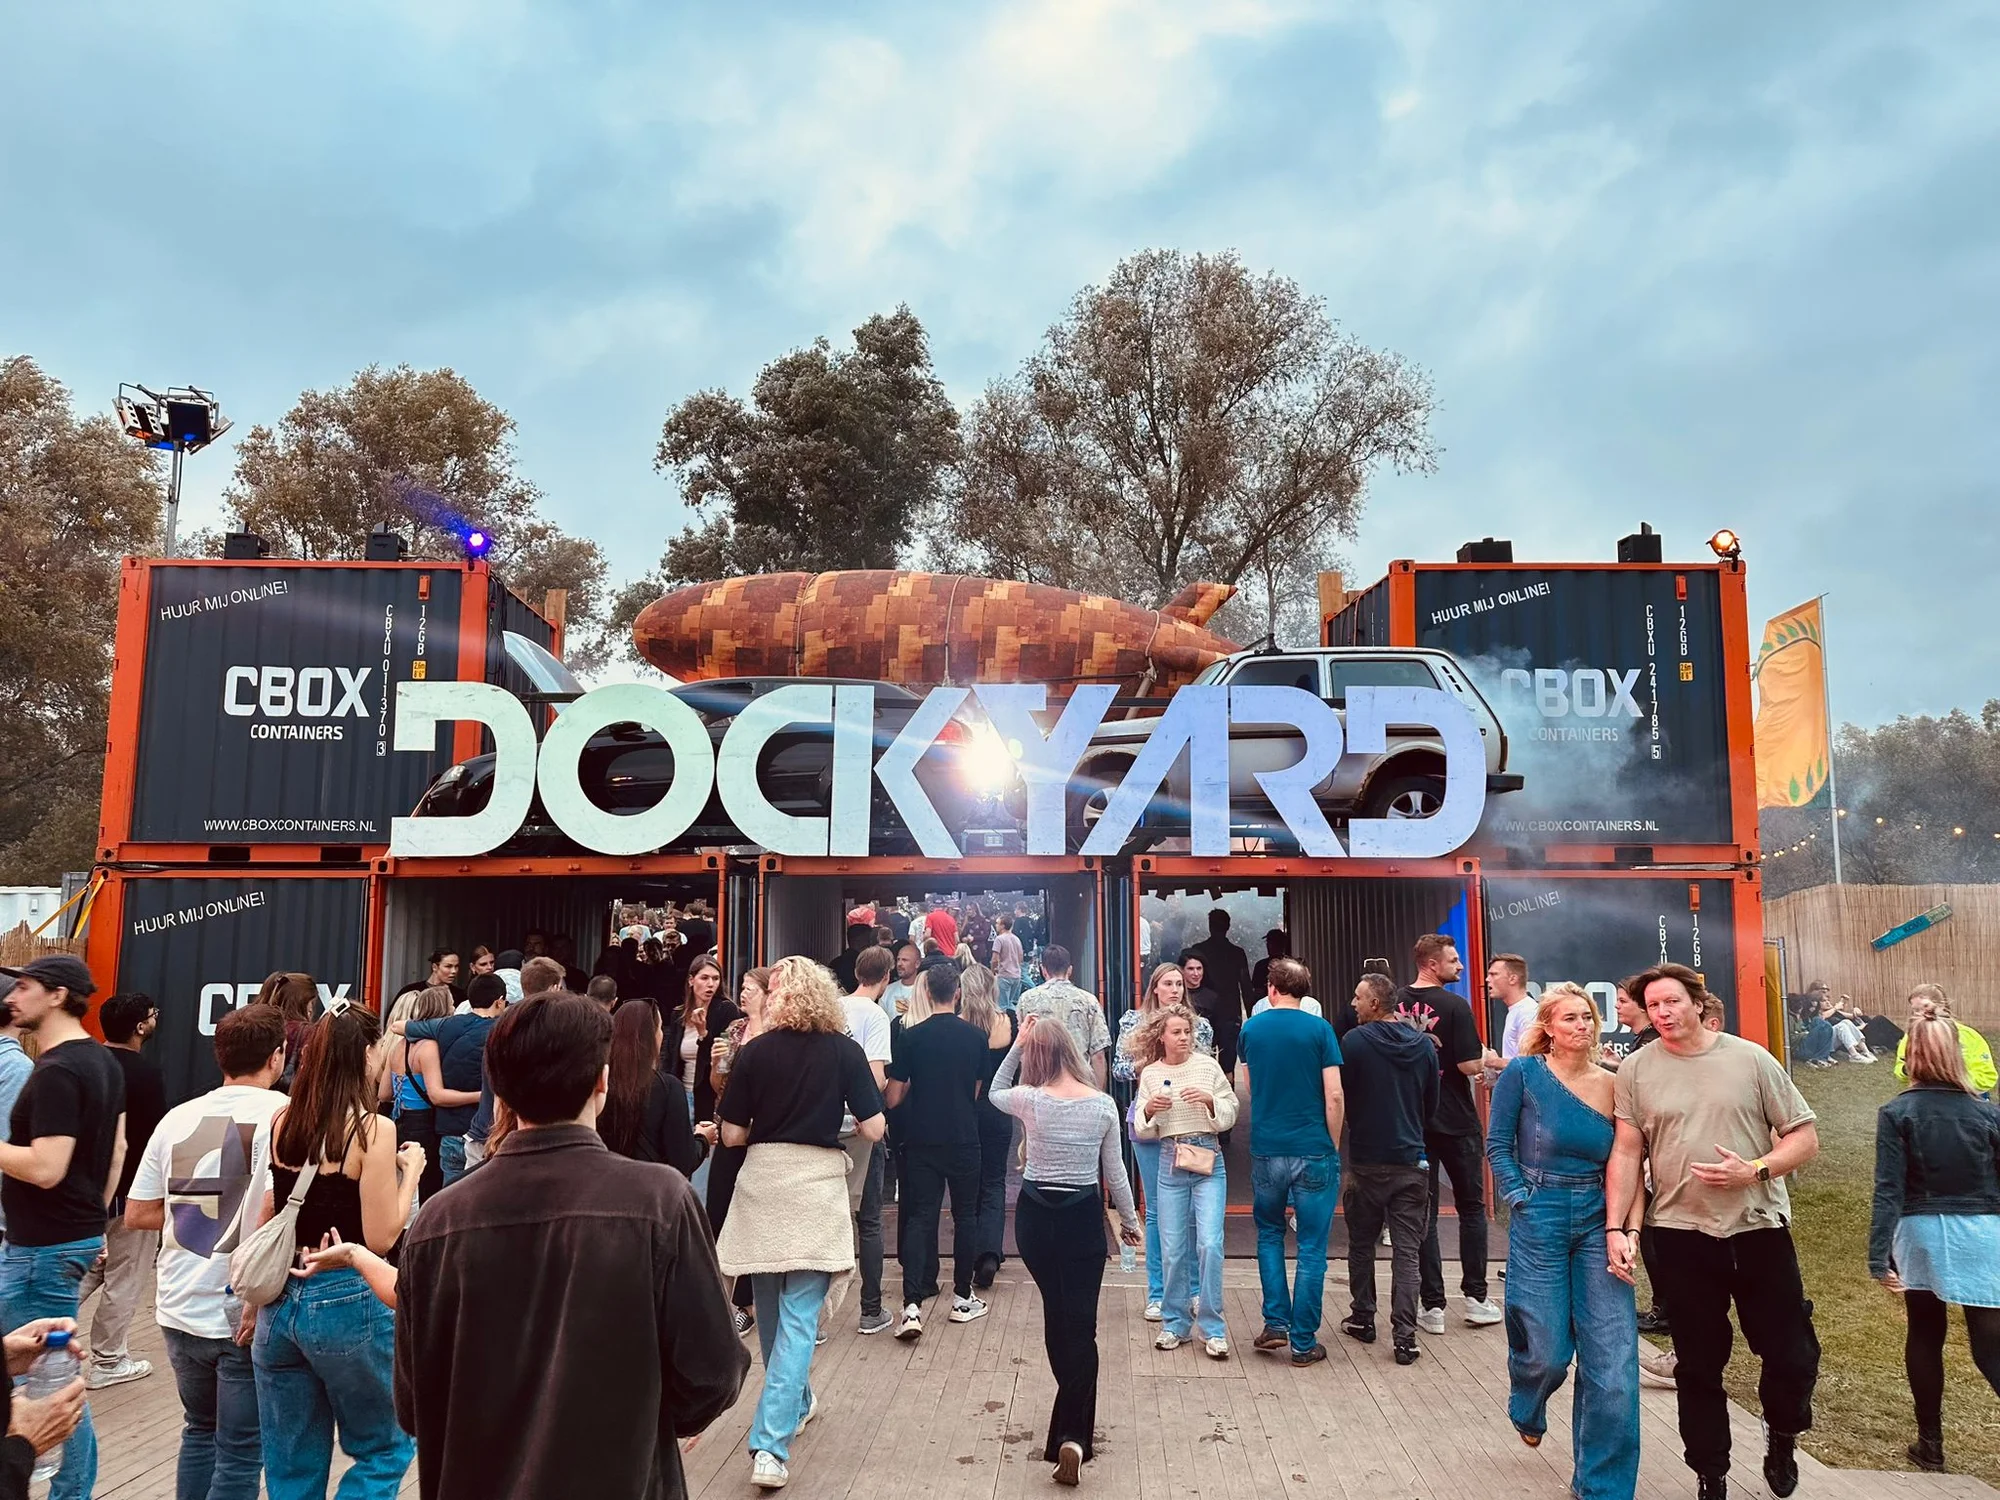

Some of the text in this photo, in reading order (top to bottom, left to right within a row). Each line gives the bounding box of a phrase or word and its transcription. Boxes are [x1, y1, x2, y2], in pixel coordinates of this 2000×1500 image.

[160, 580, 289, 621] HUUR MIJ ONLINE!
[1430, 581, 1551, 625] HUUR MIJ ONLINE!
[417, 604, 427, 656] 12GB
[1679, 604, 1688, 656] 12GB
[223, 665, 373, 718] CBOX
[377, 604, 394, 756] CBXU 011370 3
[1500, 668, 1645, 718] CBOX
[1646, 604, 1662, 759] CBXU 241785 5
[250, 724, 344, 740] CONTAINERS
[1529, 727, 1619, 742] CONTAINERS
[390, 681, 1487, 859] DOCKYARD
[203, 819, 377, 832] WWW.CBOXCONTAINERS.NL
[133, 891, 266, 935] HUUR MIJ ONLINE!
[1508, 890, 1561, 916] ONLINE!
[1692, 914, 1701, 967] 12GB
